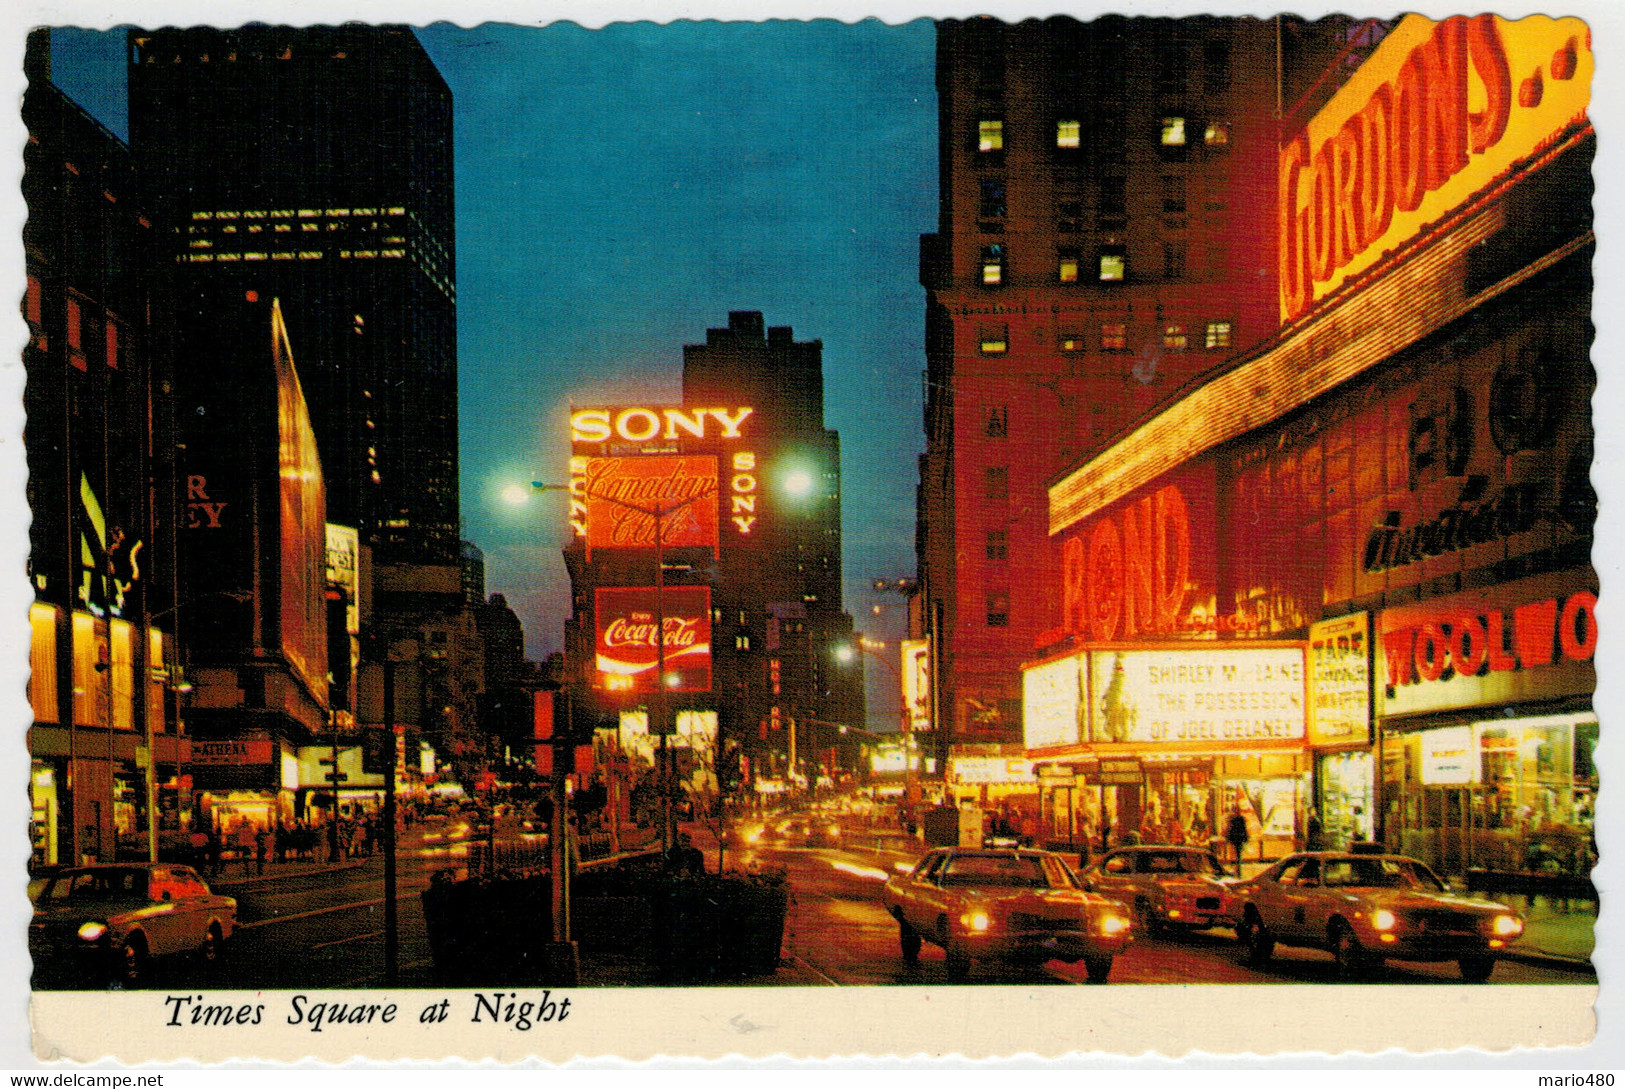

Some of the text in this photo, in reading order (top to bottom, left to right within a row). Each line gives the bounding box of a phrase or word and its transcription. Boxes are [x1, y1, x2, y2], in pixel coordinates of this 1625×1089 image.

[570, 406, 753, 442] SONY
[586, 457, 718, 500] Canadian
[732, 451, 756, 534] SONY
[1149, 664, 1215, 684] SHIRLEY
[1157, 692, 1188, 712] THE
[1195, 691, 1301, 711] POSSESSION
[1151, 718, 1293, 741] OF JOEL DELANEY
[202, 743, 248, 757] ATHENA
